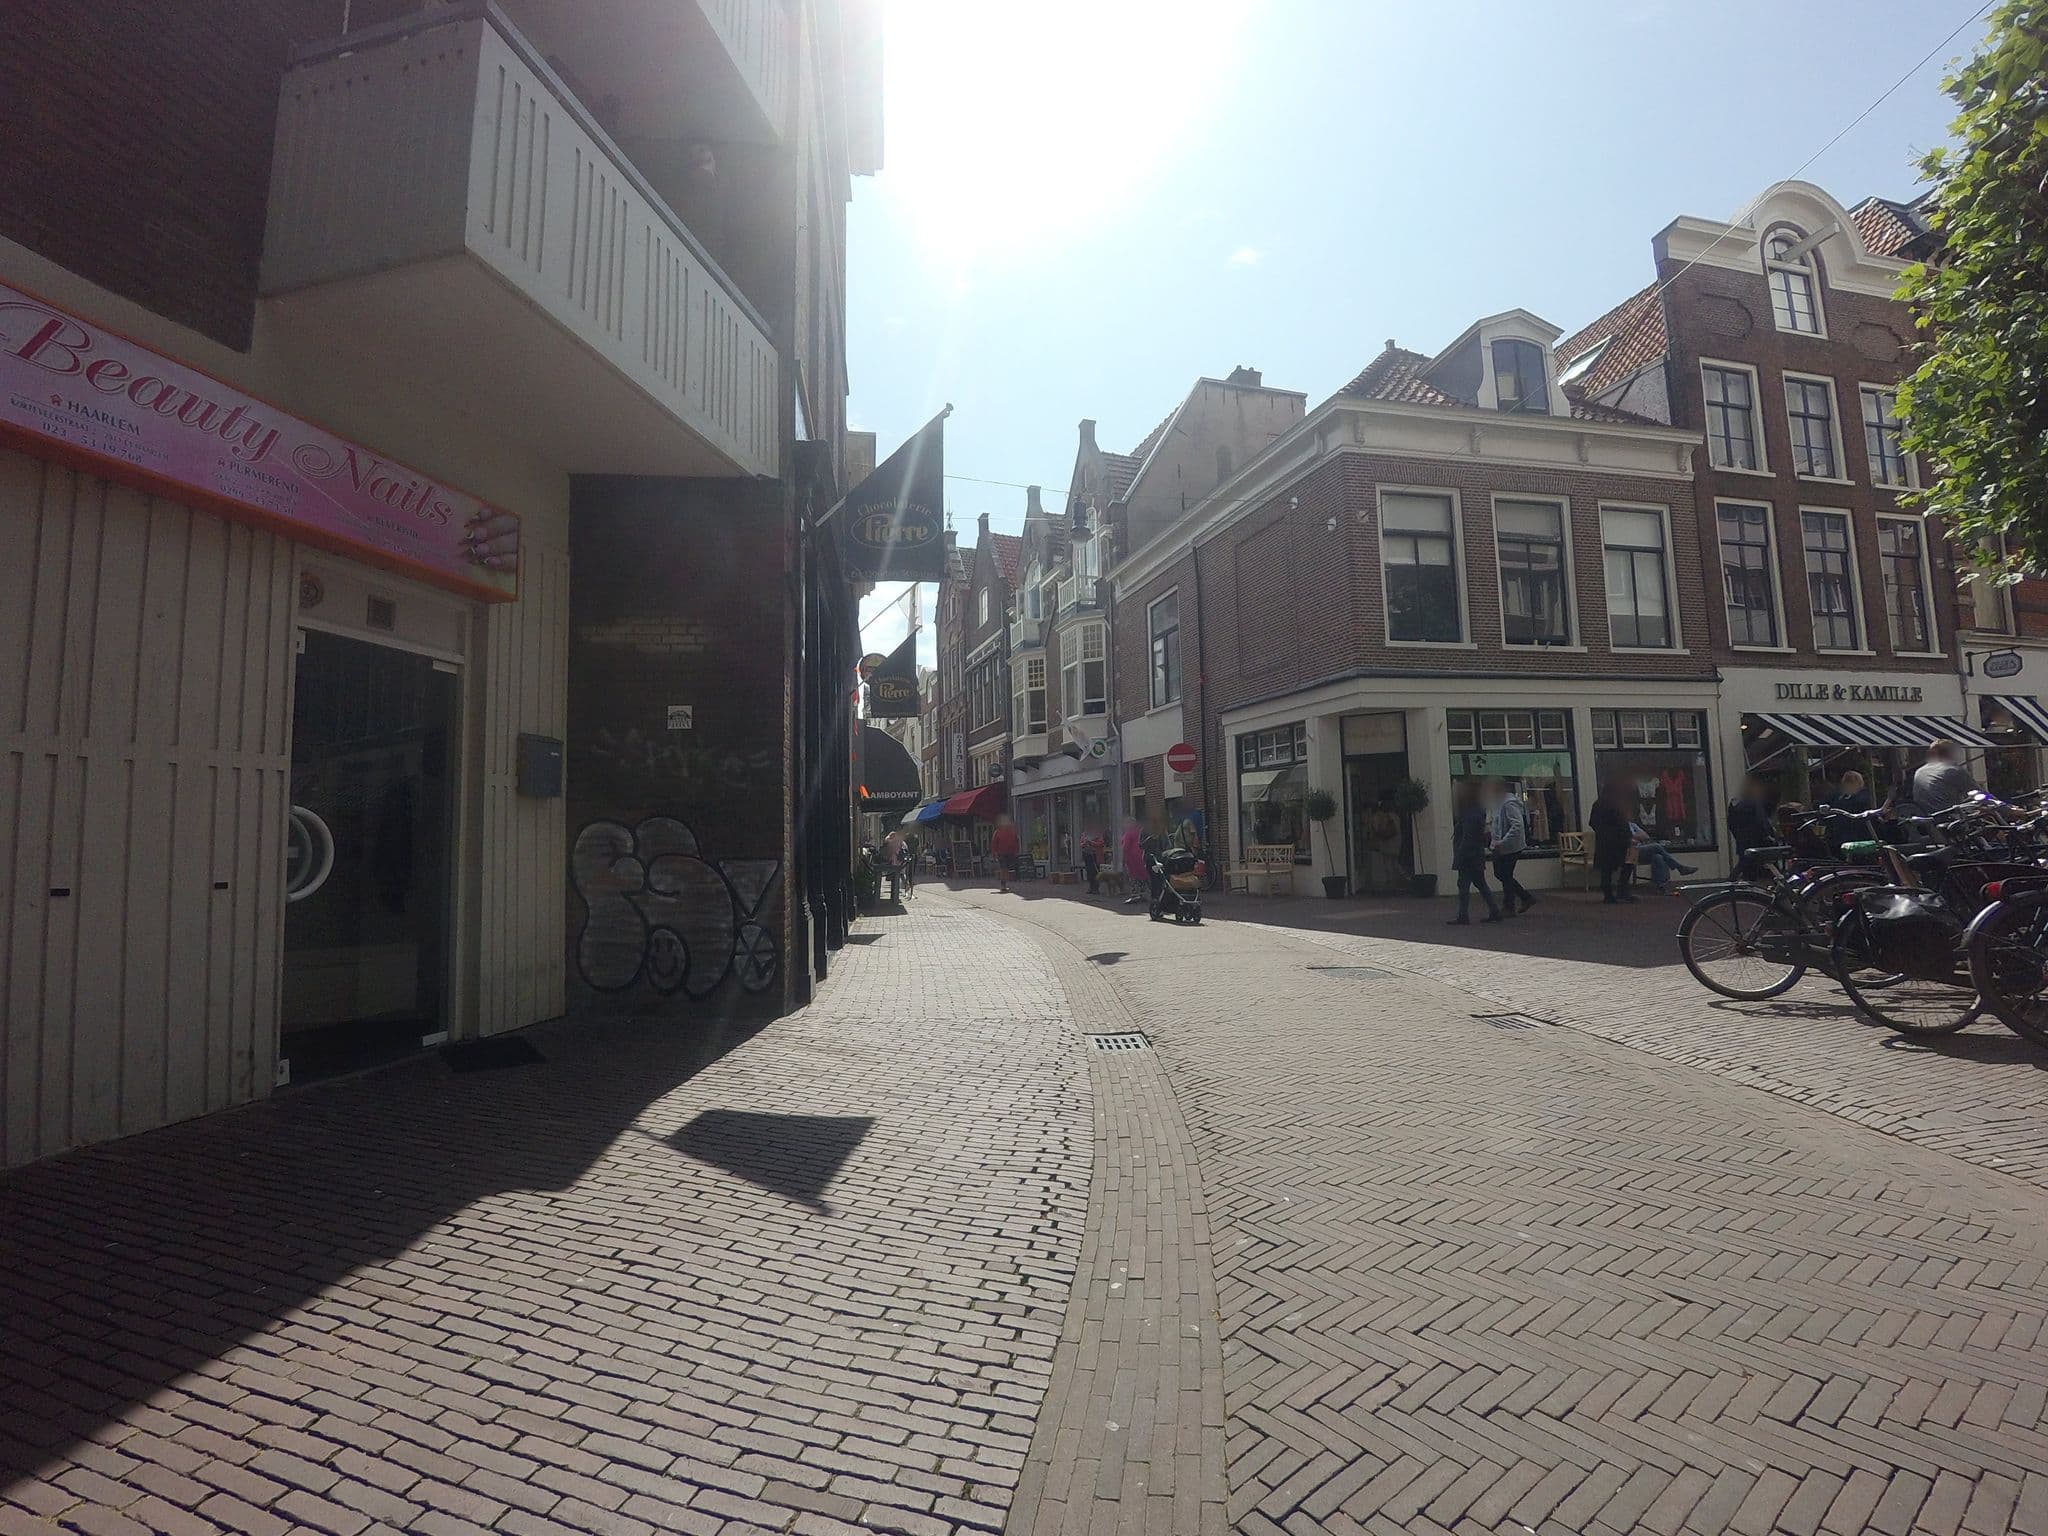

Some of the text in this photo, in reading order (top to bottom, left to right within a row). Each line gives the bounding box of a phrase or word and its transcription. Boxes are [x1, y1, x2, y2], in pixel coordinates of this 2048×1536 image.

[0, 301, 453, 527] Beauty Nails
[67, 400, 142, 437] HAARLEM
[229, 460, 300, 494] PURMEREND
[857, 496, 933, 517] Chocolerie
[863, 513, 929, 542] Pierre
[1775, 682, 1923, 703] DILLE & KAMILLE
